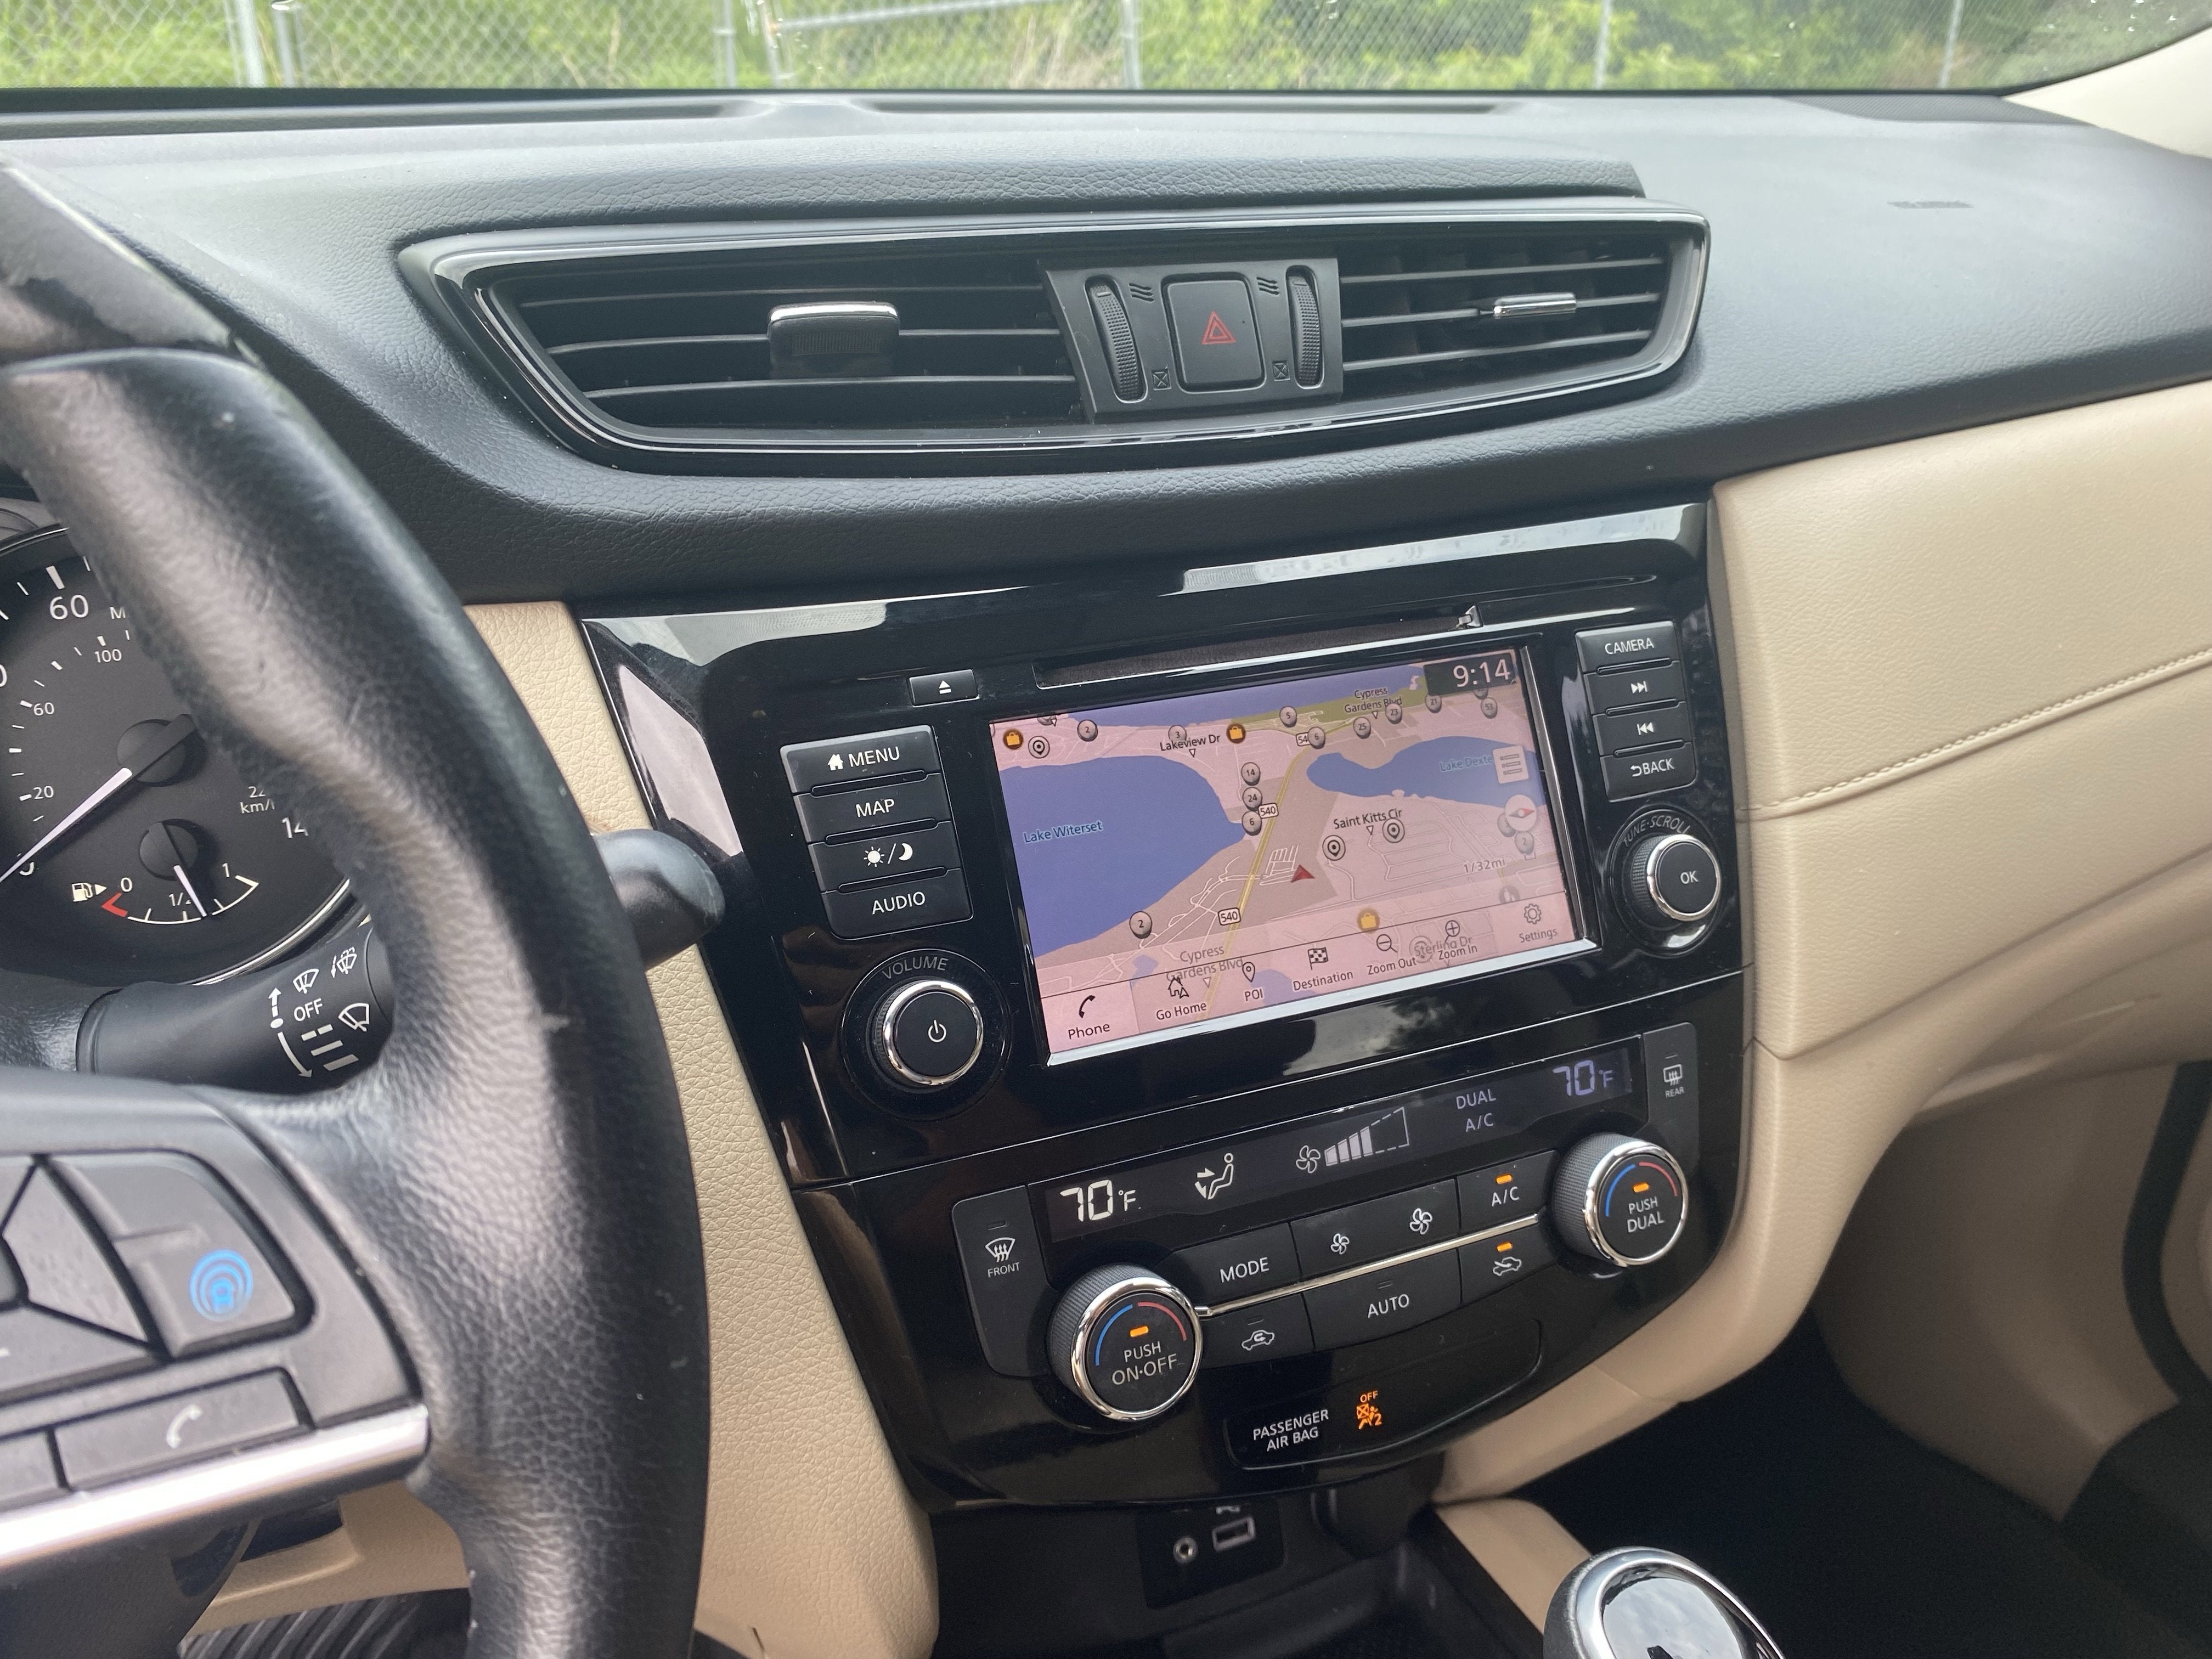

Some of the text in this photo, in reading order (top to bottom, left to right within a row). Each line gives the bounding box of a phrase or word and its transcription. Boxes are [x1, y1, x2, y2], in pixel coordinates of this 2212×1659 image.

[49, 595, 88, 620] 60
[1605, 637, 1654, 654] CAMERA
[95, 649, 122, 663] 100
[1453, 659, 1510, 687] 9:14
[1355, 688, 1387, 700] Cypress
[33, 702, 55, 716] 60
[1345, 701, 1382, 713] Gardens
[1160, 733, 1220, 752] Lakeview Dr
[848, 746, 900, 768] MENU
[1440, 755, 1493, 771] Lake Dexte
[1246, 769, 1255, 777] 14
[1643, 758, 1674, 775] BACK
[33, 785, 54, 800] 20
[1248, 794, 1257, 803] 24
[856, 799, 895, 817] MAP
[1260, 806, 1276, 816] 540
[1249, 817, 1255, 826] 6
[1334, 809, 1402, 830] Saint Kitts Cir
[1024, 821, 1103, 843] Lake Witerset
[222, 863, 230, 878] 1
[1464, 857, 1505, 873] 1/32mi
[120, 877, 133, 893] 0
[1680, 871, 1698, 884] OK
[872, 891, 926, 915] AUDIO
[1138, 919, 1144, 929] 2
[1221, 912, 1238, 922] 540
[1460, 936, 1472, 946] Dr
[1519, 928, 1558, 944] Settings
[1180, 946, 1224, 964] Cypress
[1437, 945, 1477, 960] Zoom In
[882, 956, 949, 979] VOLUME
[1166, 958, 1243, 982] Gardens Blvd
[1367, 957, 1417, 975] Zoom Out
[1293, 970, 1353, 991] Destination
[1245, 989, 1263, 1001] POI
[294, 998, 323, 1022] OFF
[1156, 1003, 1206, 1020] Go Home
[1069, 1023, 1110, 1040] Phone
[1456, 1088, 1496, 1109] DUAL
[1665, 1086, 1684, 1098] REAR
[1465, 1113, 1493, 1132] A/C
[1491, 1187, 1520, 1207] A/C
[1628, 1197, 1658, 1215] PUSH
[1627, 1214, 1664, 1233] DUAL
[988, 1262, 1020, 1278] FRONT
[1220, 1257, 1269, 1283] MODE
[1368, 1293, 1410, 1318] AUTO
[1124, 1342, 1161, 1362] PUSH
[1360, 1390, 1378, 1403] OFF
[1253, 1409, 1329, 1440] PASSENGER
[1266, 1427, 1319, 1452] AIR BAG
